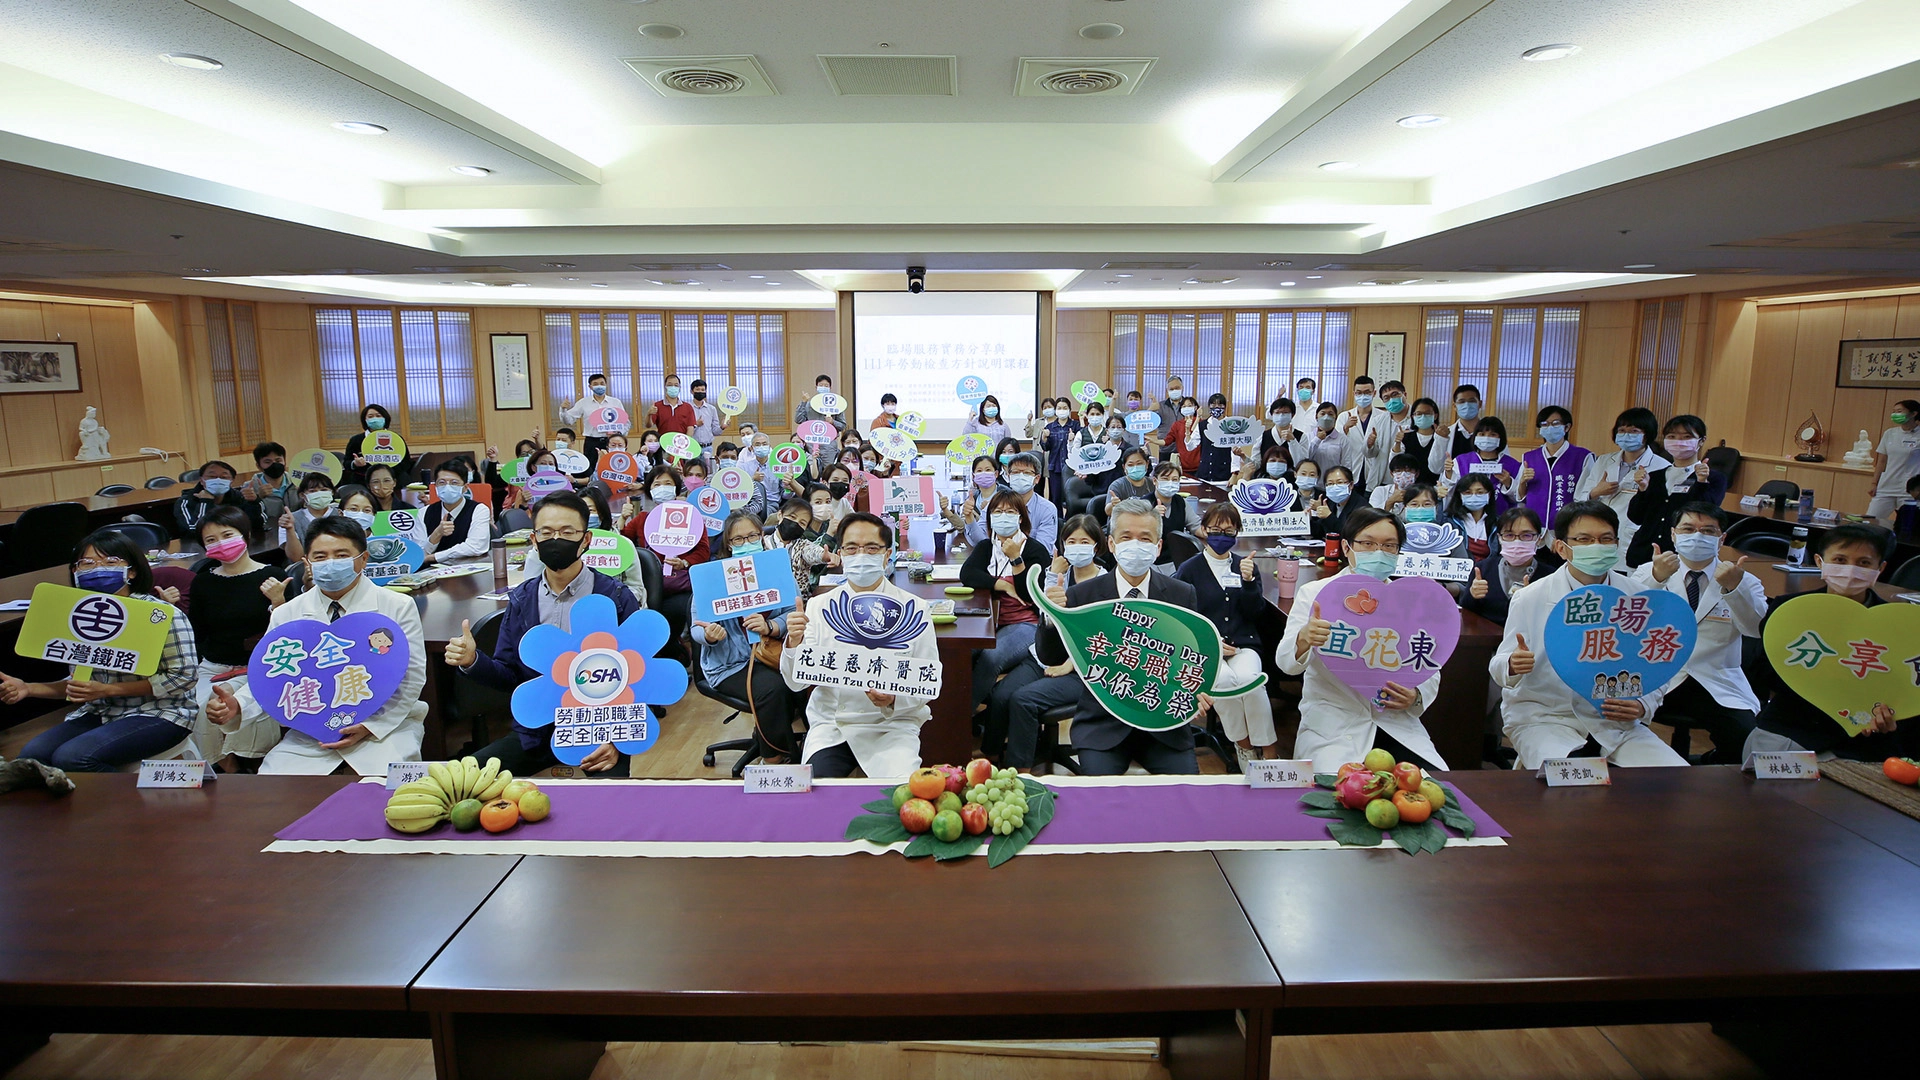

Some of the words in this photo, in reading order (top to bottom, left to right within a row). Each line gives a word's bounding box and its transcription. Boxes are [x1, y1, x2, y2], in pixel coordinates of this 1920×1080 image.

[886, 342, 1006, 356] 臨場服務實務分享與
[863, 357, 1030, 371] 111年勞動檢查方針說明課程
[1220, 435, 1252, 446] 慈濟大學
[1078, 459, 1113, 471] 慈濟科技大學
[601, 470, 634, 484] 台灣中油
[884, 503, 924, 514] 門諾醫院
[1242, 516, 1307, 528] 慈濟醫療財團法人
[649, 533, 695, 547] 信大水泥
[1396, 556, 1471, 573] 慈濟醫院
[1436, 571, 1468, 580] Hospita
[714, 589, 778, 614] 門諾基金會
[1112, 602, 1157, 630] Happy
[1565, 592, 1651, 634] 臨場
[1121, 626, 1175, 656] Labour
[1179, 645, 1208, 667] Day
[1319, 622, 1440, 670] 宜花東
[1579, 626, 1682, 662] 服務
[45, 639, 136, 671] 台灣鐵路
[263, 633, 353, 674] 安全
[1086, 631, 1206, 694] 幸福職場
[798, 647, 938, 682] 花蓮慈濟醫院
[575, 667, 622, 685] OSHA
[795, 670, 840, 685] Hualien
[842, 676, 863, 688] Tzu
[866, 679, 887, 690] Chi
[889, 682, 937, 697] Hospital
[278, 666, 371, 718] 健康
[1083, 663, 1194, 721] 以你為榮
[556, 704, 645, 725] 勞動部職業
[556, 723, 645, 745] 安全衛生署
[153, 770, 187, 782] 劉鴻文
[1263, 770, 1298, 782] 陳星助
[1559, 767, 1594, 780] 黃亮凱
[1769, 762, 1801, 774] 林純吉
[758, 776, 794, 788] 林欣榮
